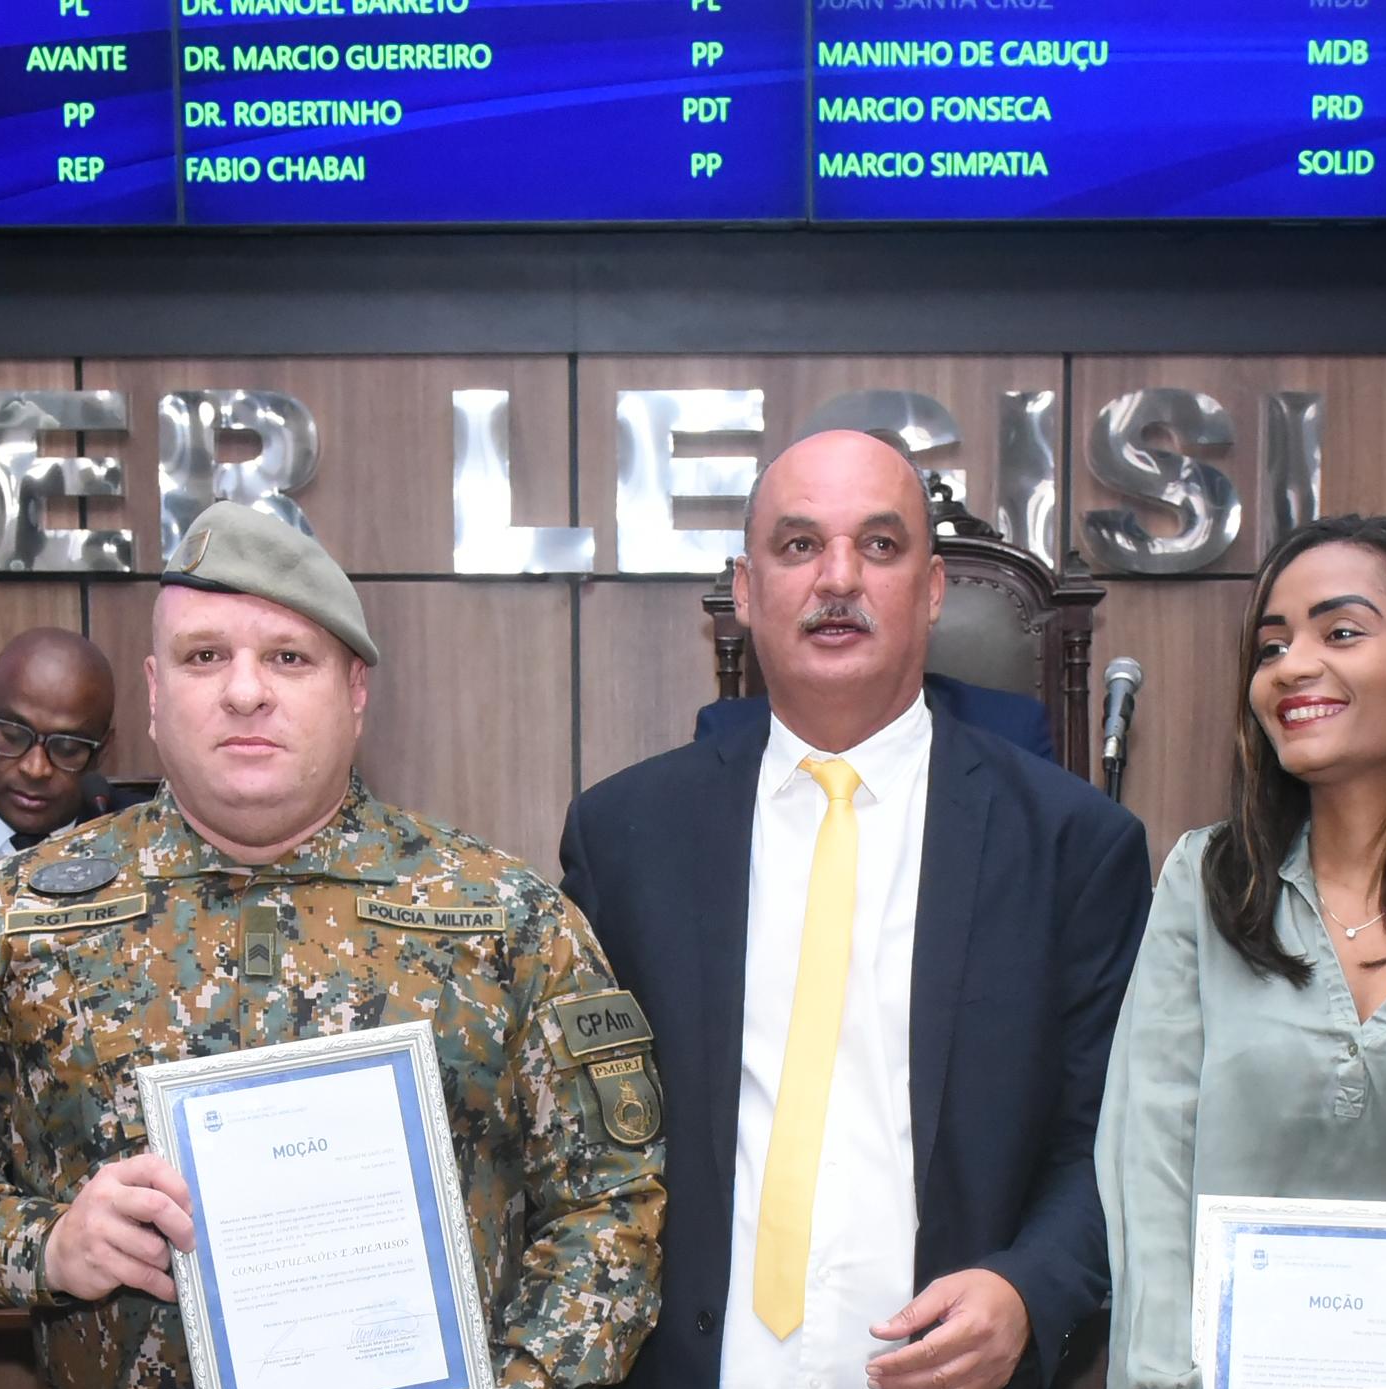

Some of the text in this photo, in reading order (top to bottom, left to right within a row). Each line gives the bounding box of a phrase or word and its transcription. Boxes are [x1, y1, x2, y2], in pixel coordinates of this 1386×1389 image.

[26, 46, 127, 71] AVANTE
[184, 44, 492, 71] DR. MARCIO GUERREIRO
[692, 42, 723, 67] PP
[819, 40, 1108, 72] MANINHO DE CABUÇU
[1308, 40, 1369, 65] MDB
[64, 103, 95, 127] PP
[185, 100, 402, 127] DR. ROBERTINHO
[683, 97, 731, 123] PDT
[819, 96, 1052, 122] MARCIO FONSECA
[1312, 95, 1363, 120] PRD
[58, 157, 104, 182] REP
[186, 156, 365, 182] FABIO CHABAI
[691, 153, 722, 178] PP
[819, 152, 1048, 177] MARCIO SIMPATIA
[1298, 150, 1374, 175] SOLID
[34, 905, 118, 925] SGT TRE
[368, 903, 493, 926] POLÍCIA MILITAR
[594, 1059, 641, 1077] PMERJ
[272, 1136, 328, 1160] MOÇÃO
[351, 1238, 410, 1257] APLAUSOS
[1309, 1293, 1364, 1312] MOÇÃO
